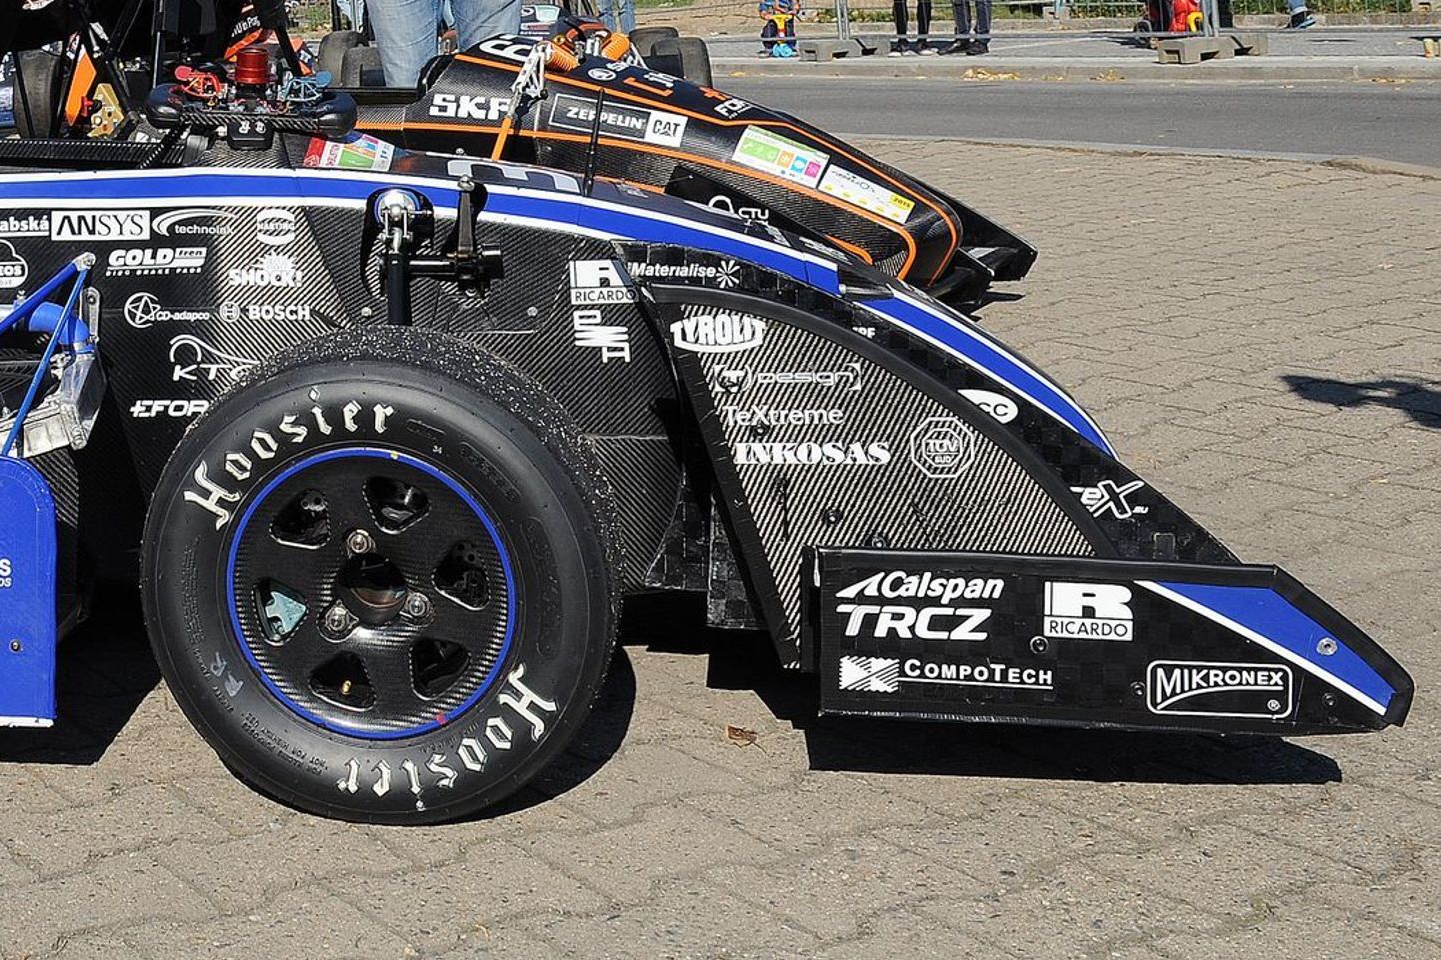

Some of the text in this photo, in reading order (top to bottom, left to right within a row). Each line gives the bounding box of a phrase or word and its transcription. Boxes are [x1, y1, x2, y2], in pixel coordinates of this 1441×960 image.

[653, 119, 681, 137] CAT
[738, 207, 770, 220] CTU
[55, 215, 146, 237] ANSYS
[108, 248, 175, 266] GOLD
[228, 268, 304, 287] SHOCK!
[574, 289, 638, 303] RICARDO
[247, 305, 311, 321] BOSCH
[670, 313, 767, 346] TYROLIT
[721, 404, 845, 426] TeXtreme
[183, 387, 395, 531] Hoosier
[733, 442, 892, 465] INKOSAS
[881, 570, 1005, 605] Calspan
[836, 604, 993, 641] TRCZ
[1049, 619, 1129, 638] RICARDO
[1156, 667, 1284, 706] MIKRONEX
[335, 663, 557, 811] Hoosier
